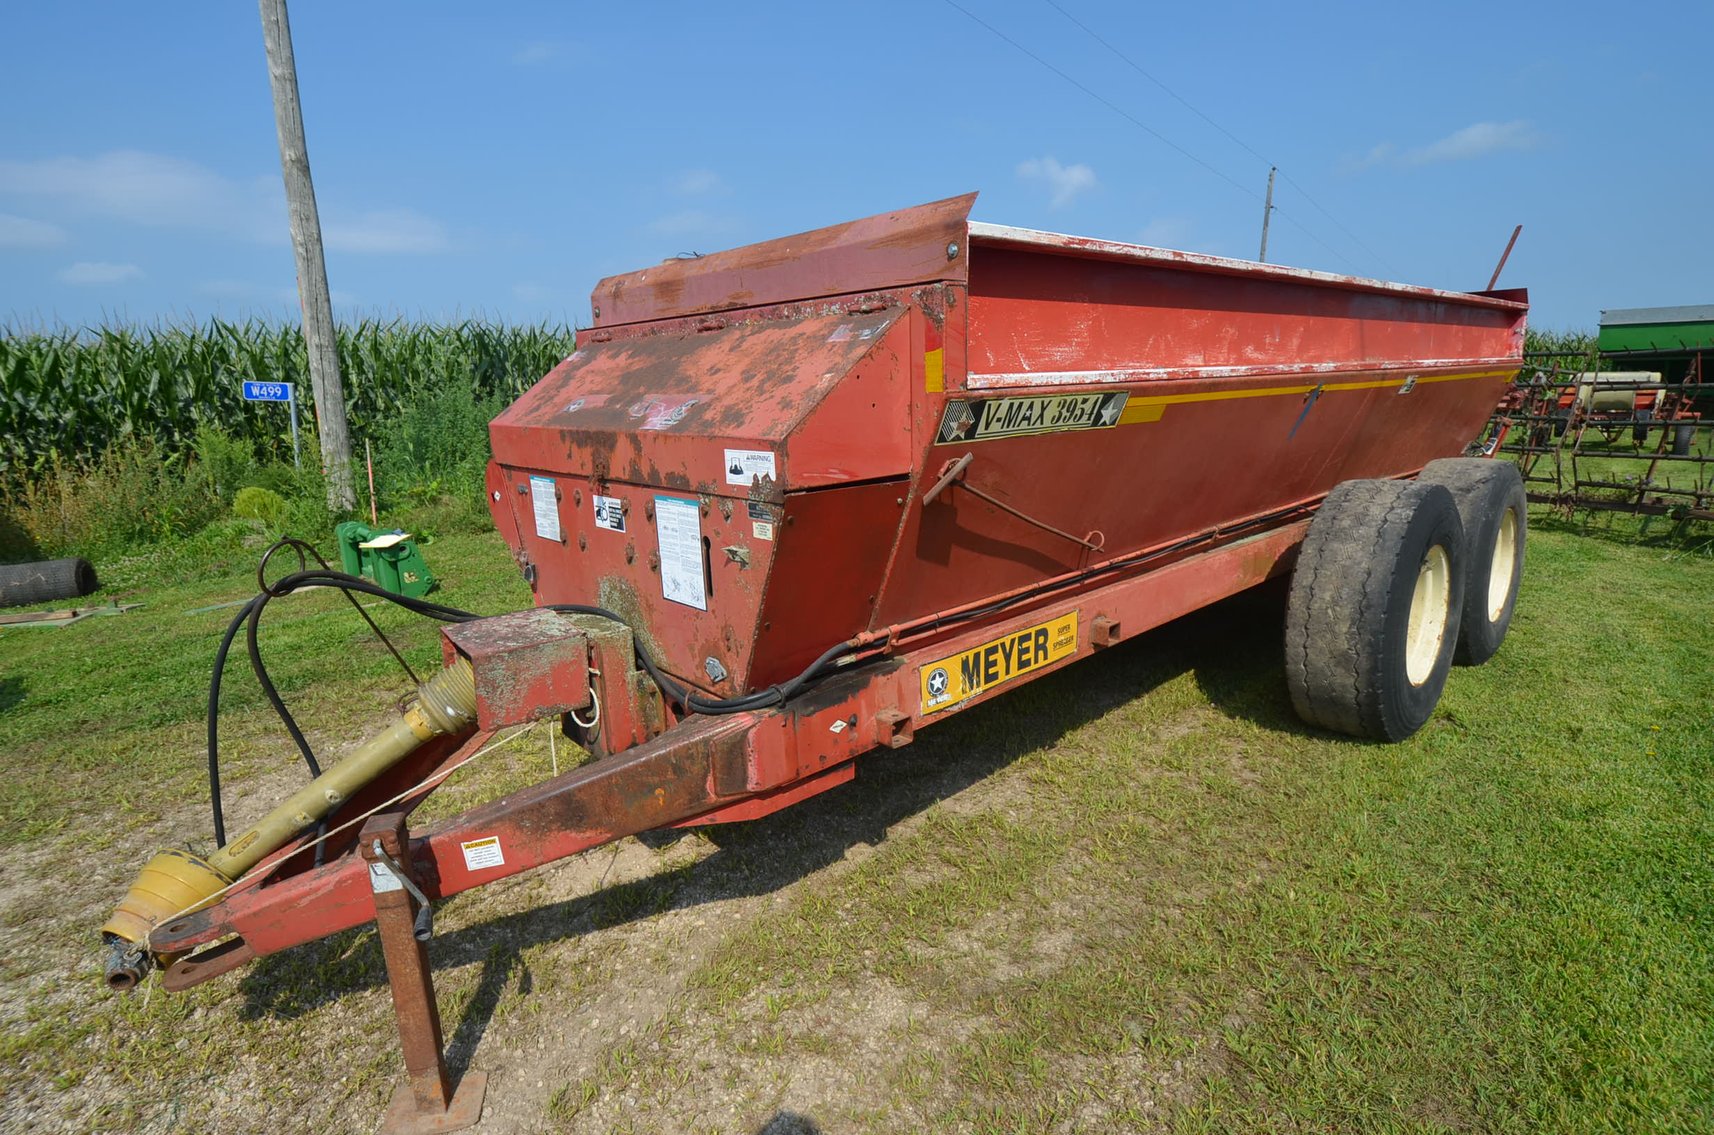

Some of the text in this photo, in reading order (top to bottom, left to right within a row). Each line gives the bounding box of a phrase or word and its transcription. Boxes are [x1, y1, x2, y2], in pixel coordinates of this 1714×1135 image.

[250, 386, 282, 397] W499
[985, 397, 1099, 431] V-MAX 3954
[750, 454, 771, 463] WARNING
[961, 627, 1049, 695] MEYER
